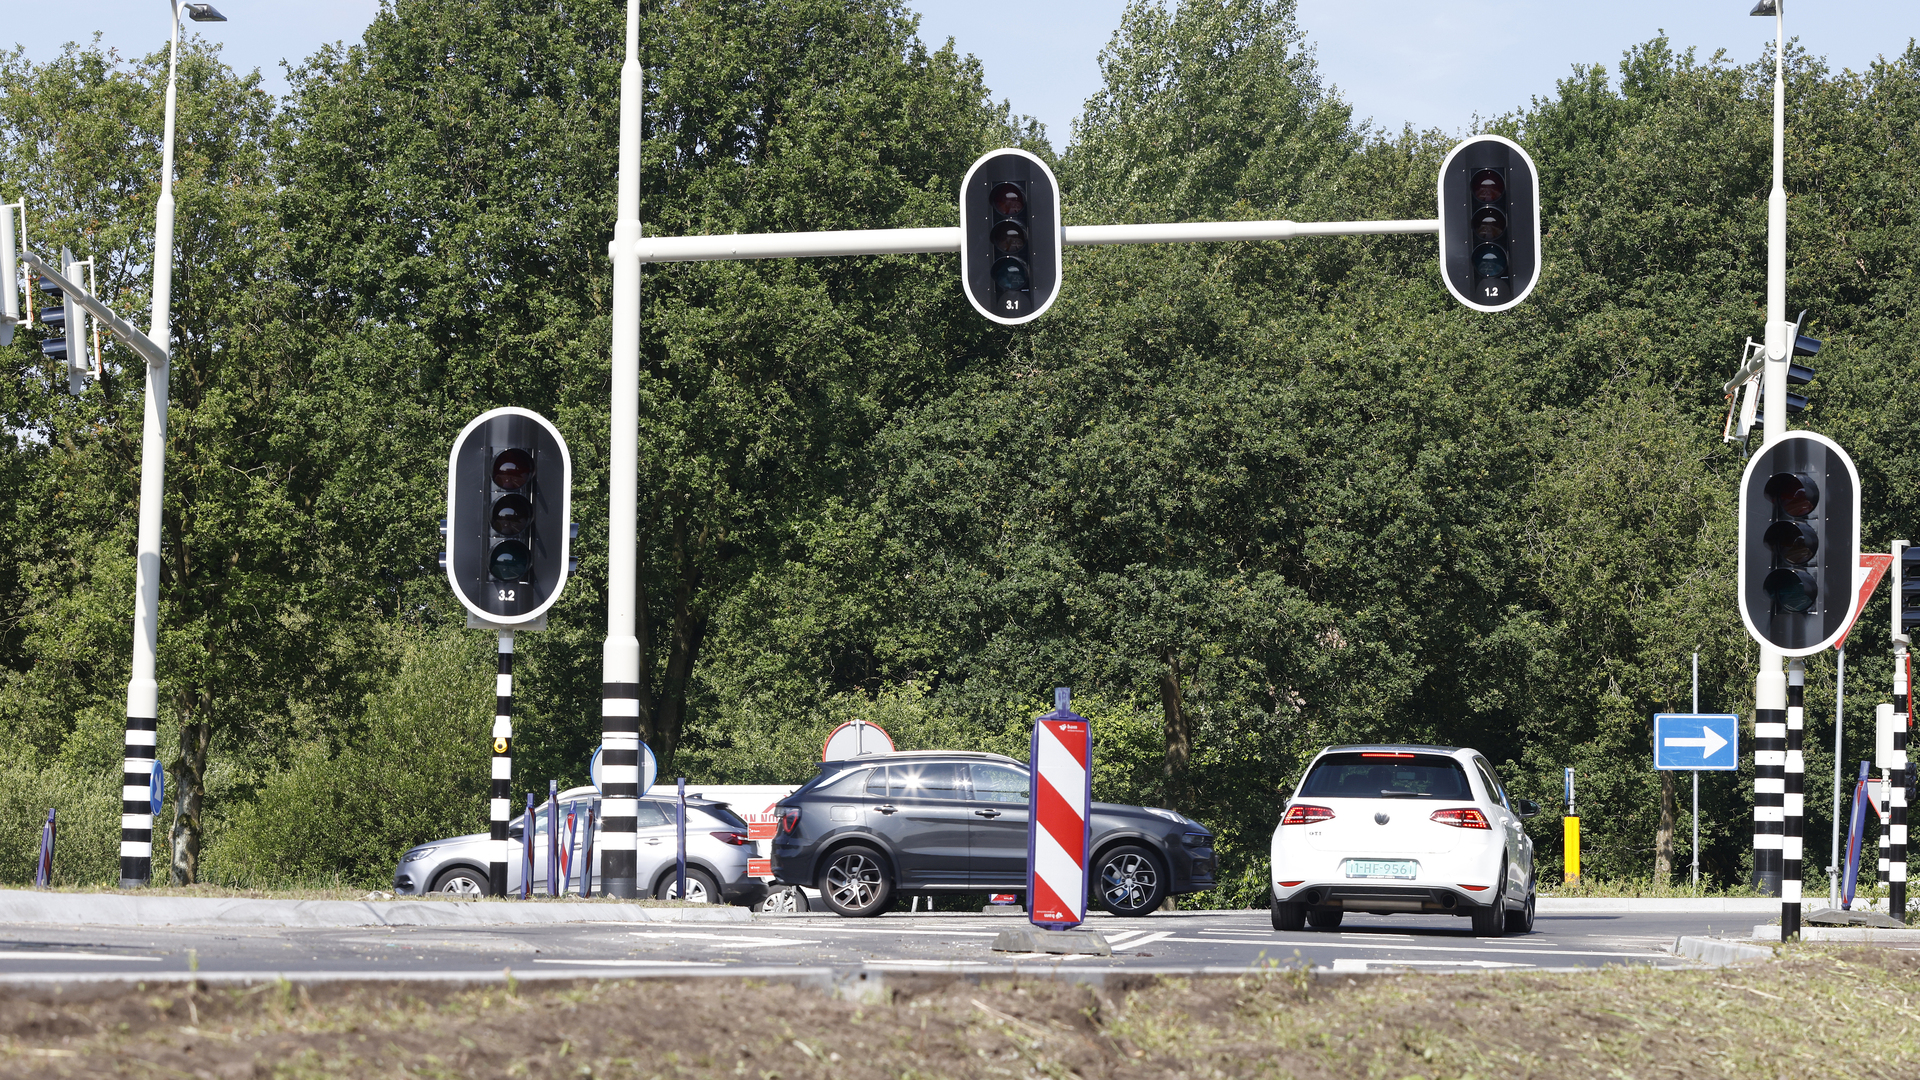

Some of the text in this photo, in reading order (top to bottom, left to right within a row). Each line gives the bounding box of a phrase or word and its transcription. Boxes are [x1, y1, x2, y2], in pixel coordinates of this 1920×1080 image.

[1484, 287, 1499, 297] 1.2
[1006, 299, 1019, 310] 3.1
[498, 589, 515, 601] 3.2
